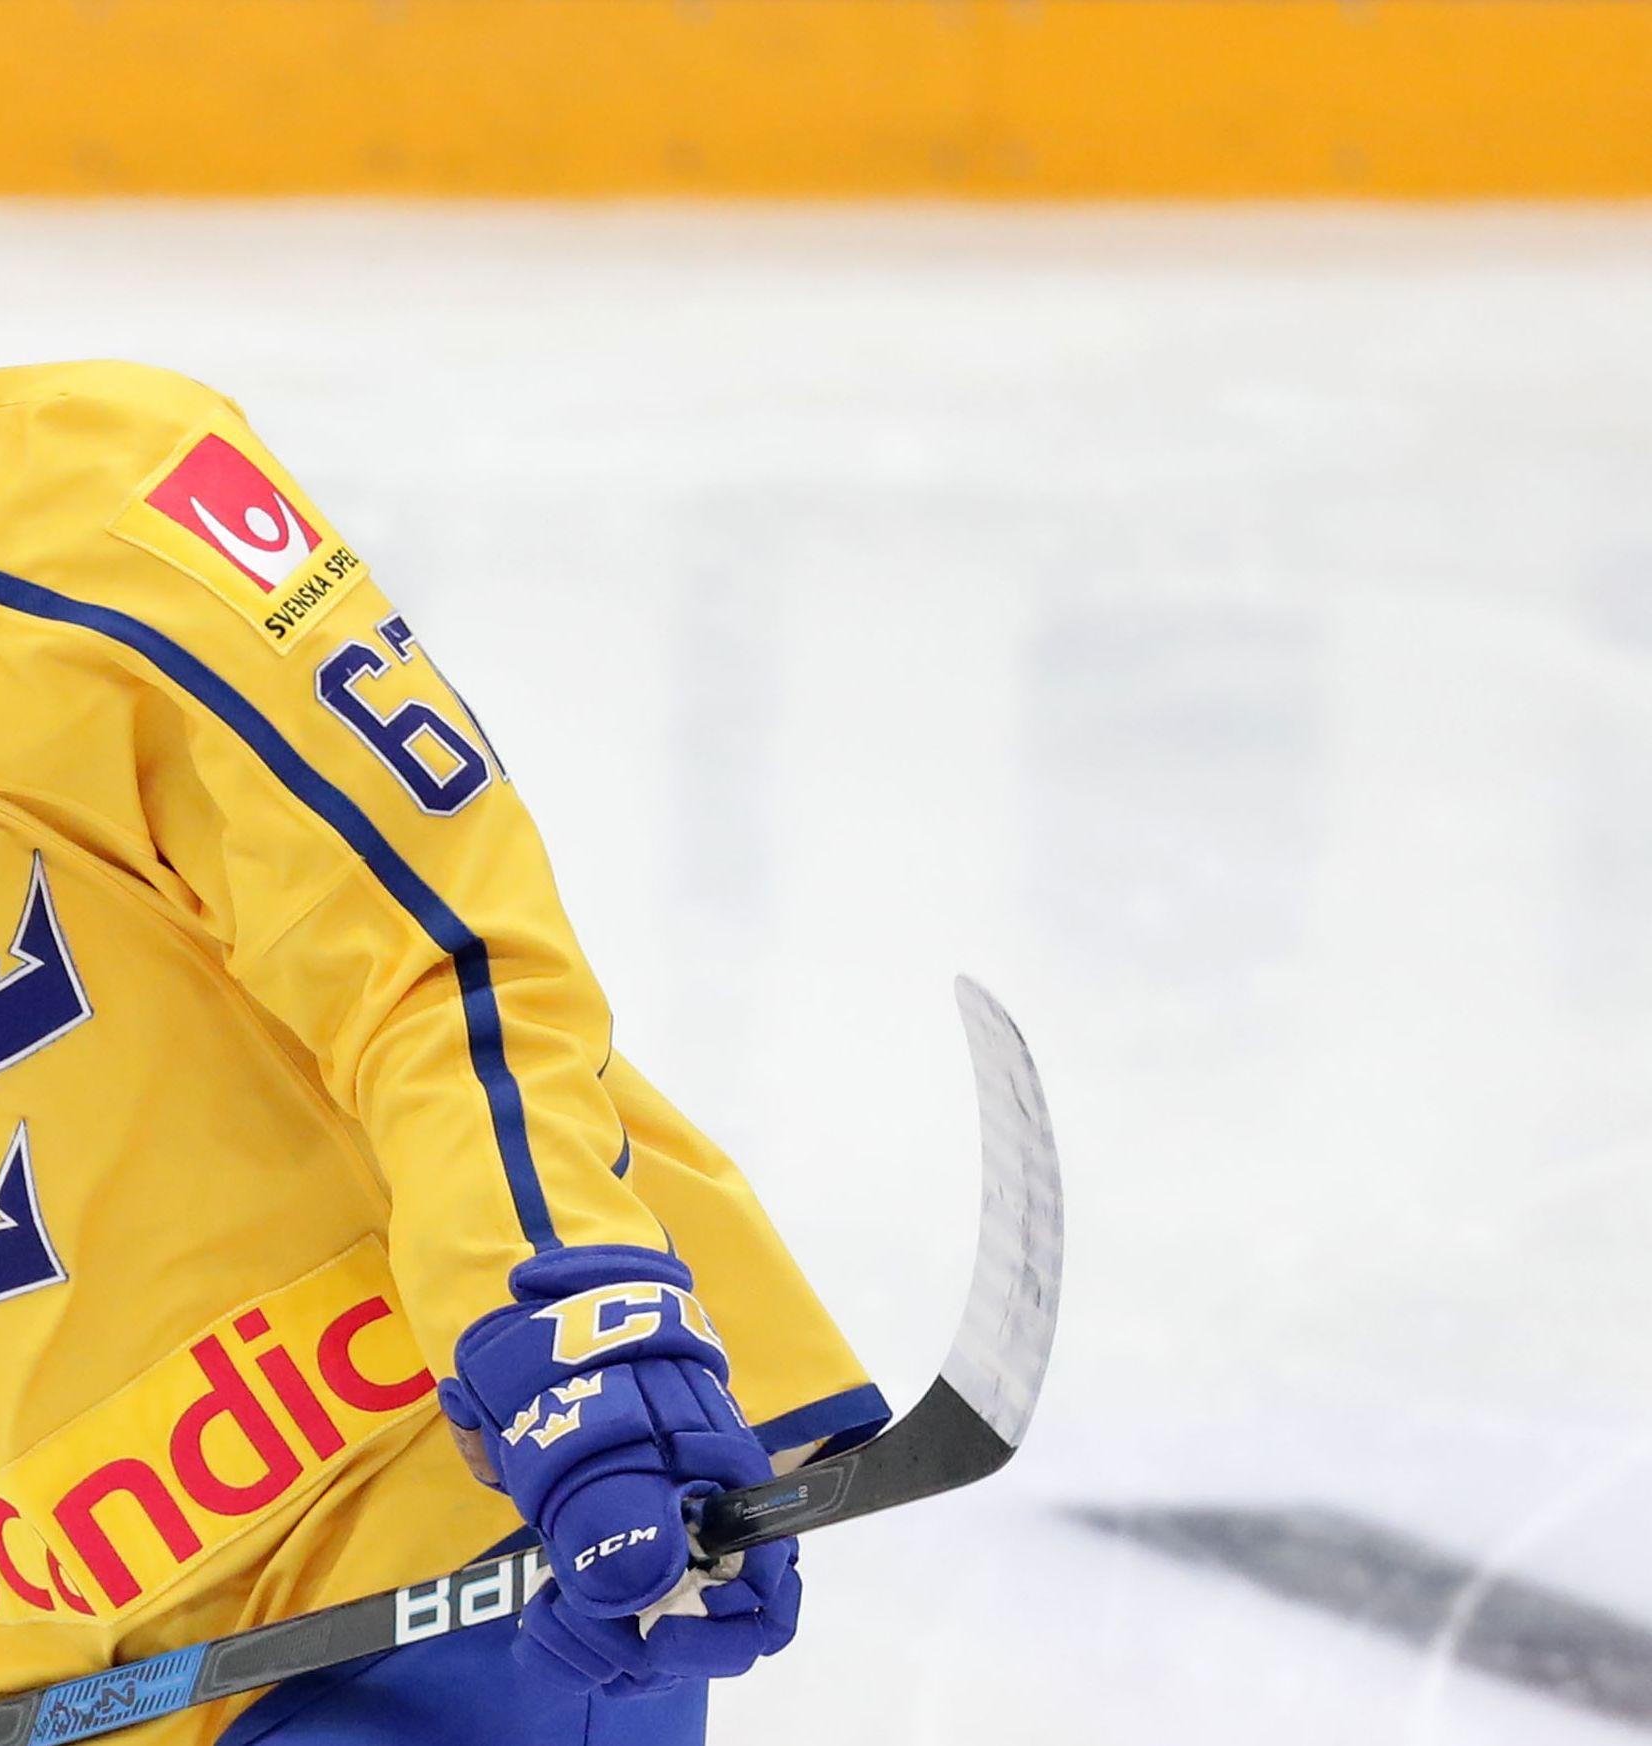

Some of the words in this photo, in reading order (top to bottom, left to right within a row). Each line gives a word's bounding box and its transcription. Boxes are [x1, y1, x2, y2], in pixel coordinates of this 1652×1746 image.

[264, 574, 334, 640] SVENSKA
[324, 546, 360, 580] SPEL
[574, 1526, 658, 1572] CCM
